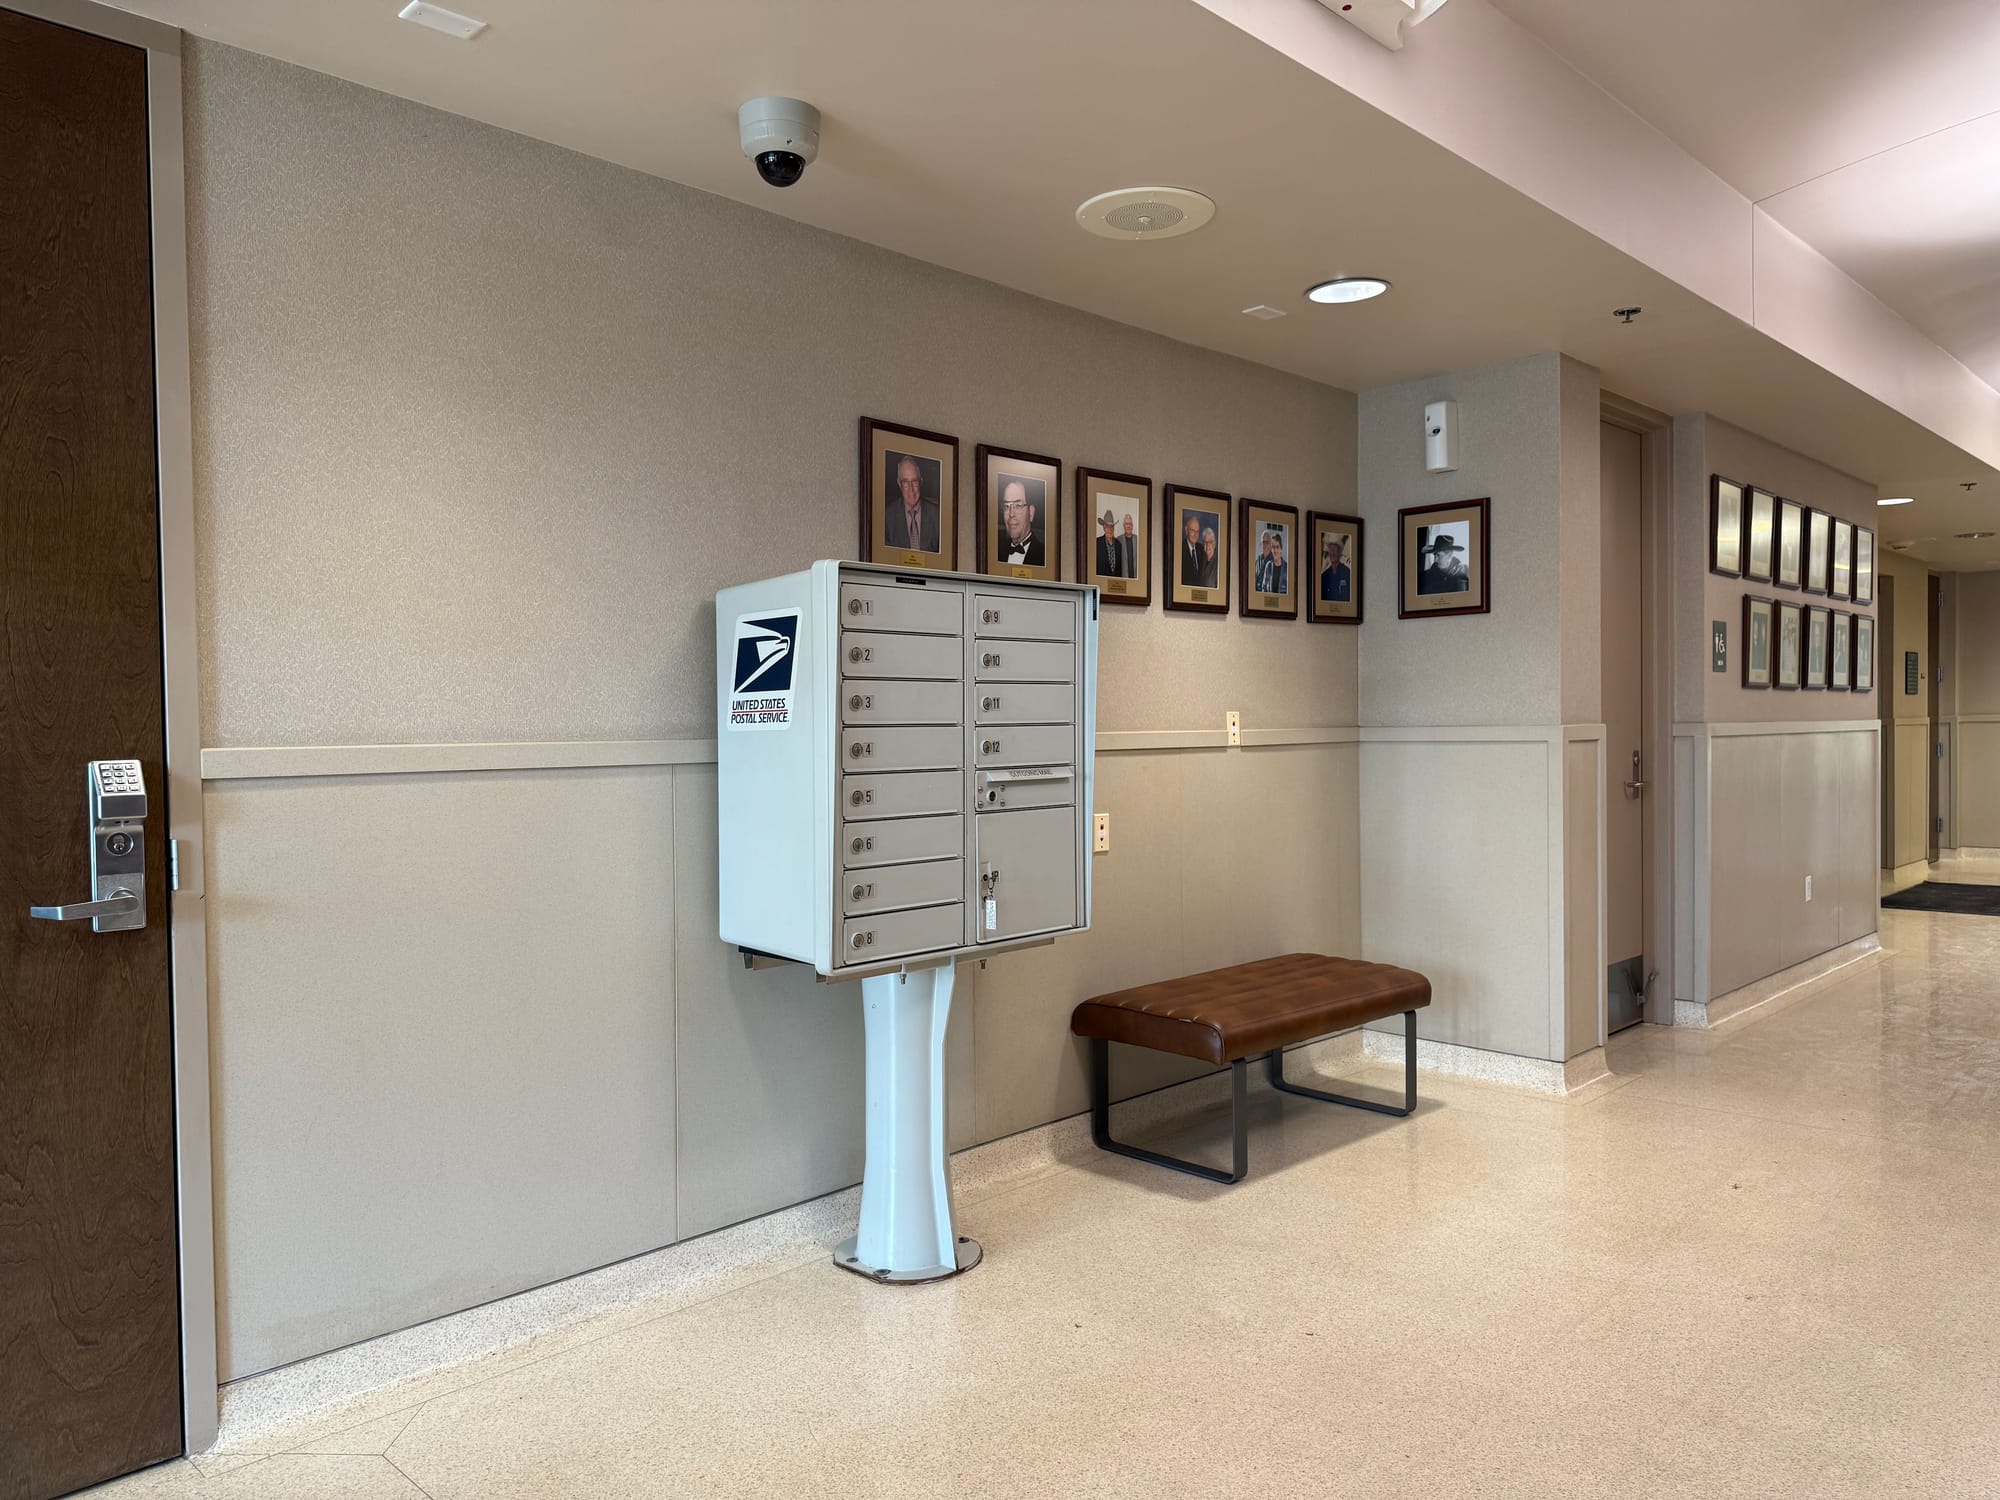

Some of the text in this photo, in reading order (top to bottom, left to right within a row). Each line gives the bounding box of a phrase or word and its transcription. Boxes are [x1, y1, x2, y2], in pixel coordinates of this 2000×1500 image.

[865, 602, 870, 613] 1
[993, 611, 999, 622] 9
[864, 649, 871, 661] 2
[992, 655, 1000, 666] 10
[732, 697, 786, 711] UNITED STATES
[865, 696, 871, 708] 3
[992, 698, 1000, 709] 11
[731, 713, 757, 725] POSTAL
[865, 743, 871, 755] 4
[992, 741, 1000, 753] 12
[865, 790, 872, 802] 5
[866, 838, 872, 850] 6
[866, 885, 872, 897] 7
[866, 932, 873, 944] 8
